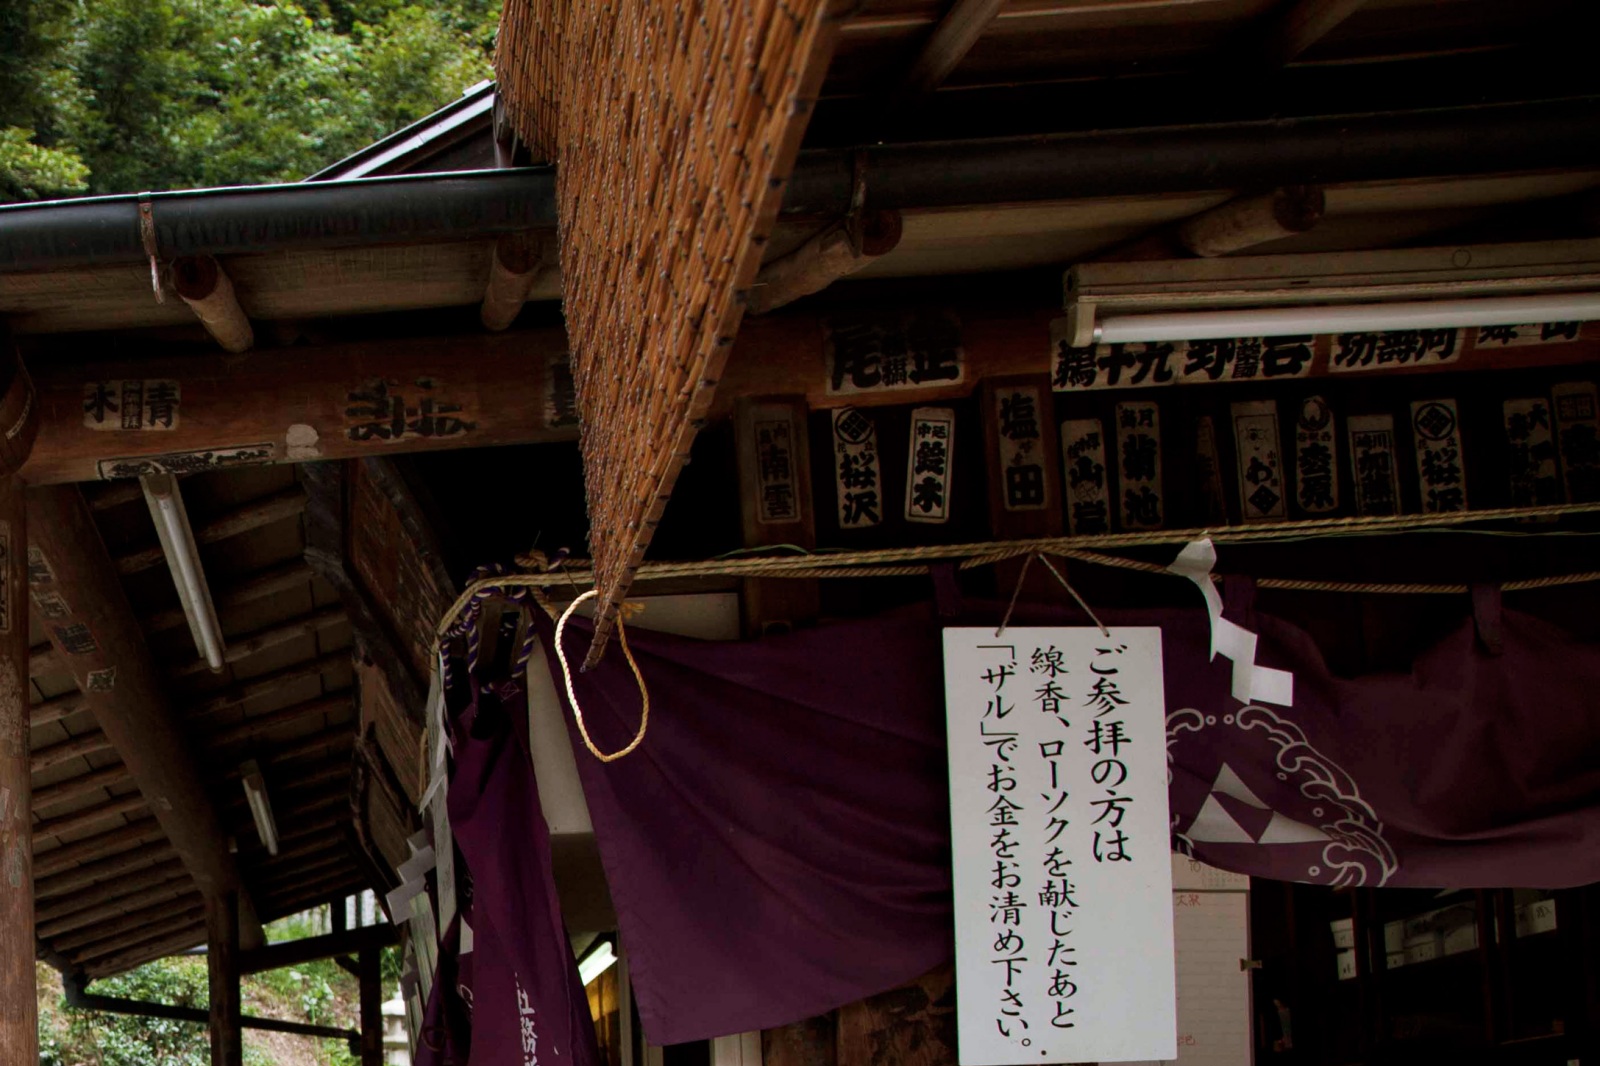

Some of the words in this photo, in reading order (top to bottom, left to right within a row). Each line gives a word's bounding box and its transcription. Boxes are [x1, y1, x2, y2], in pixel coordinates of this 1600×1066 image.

[975, 645, 1032, 1049] 「ザル」でお金をお清め下さい。
[1028, 645, 1081, 1030] 線香、ローソクを献じたあと
[1081, 643, 1134, 864] ご参拝の方は
